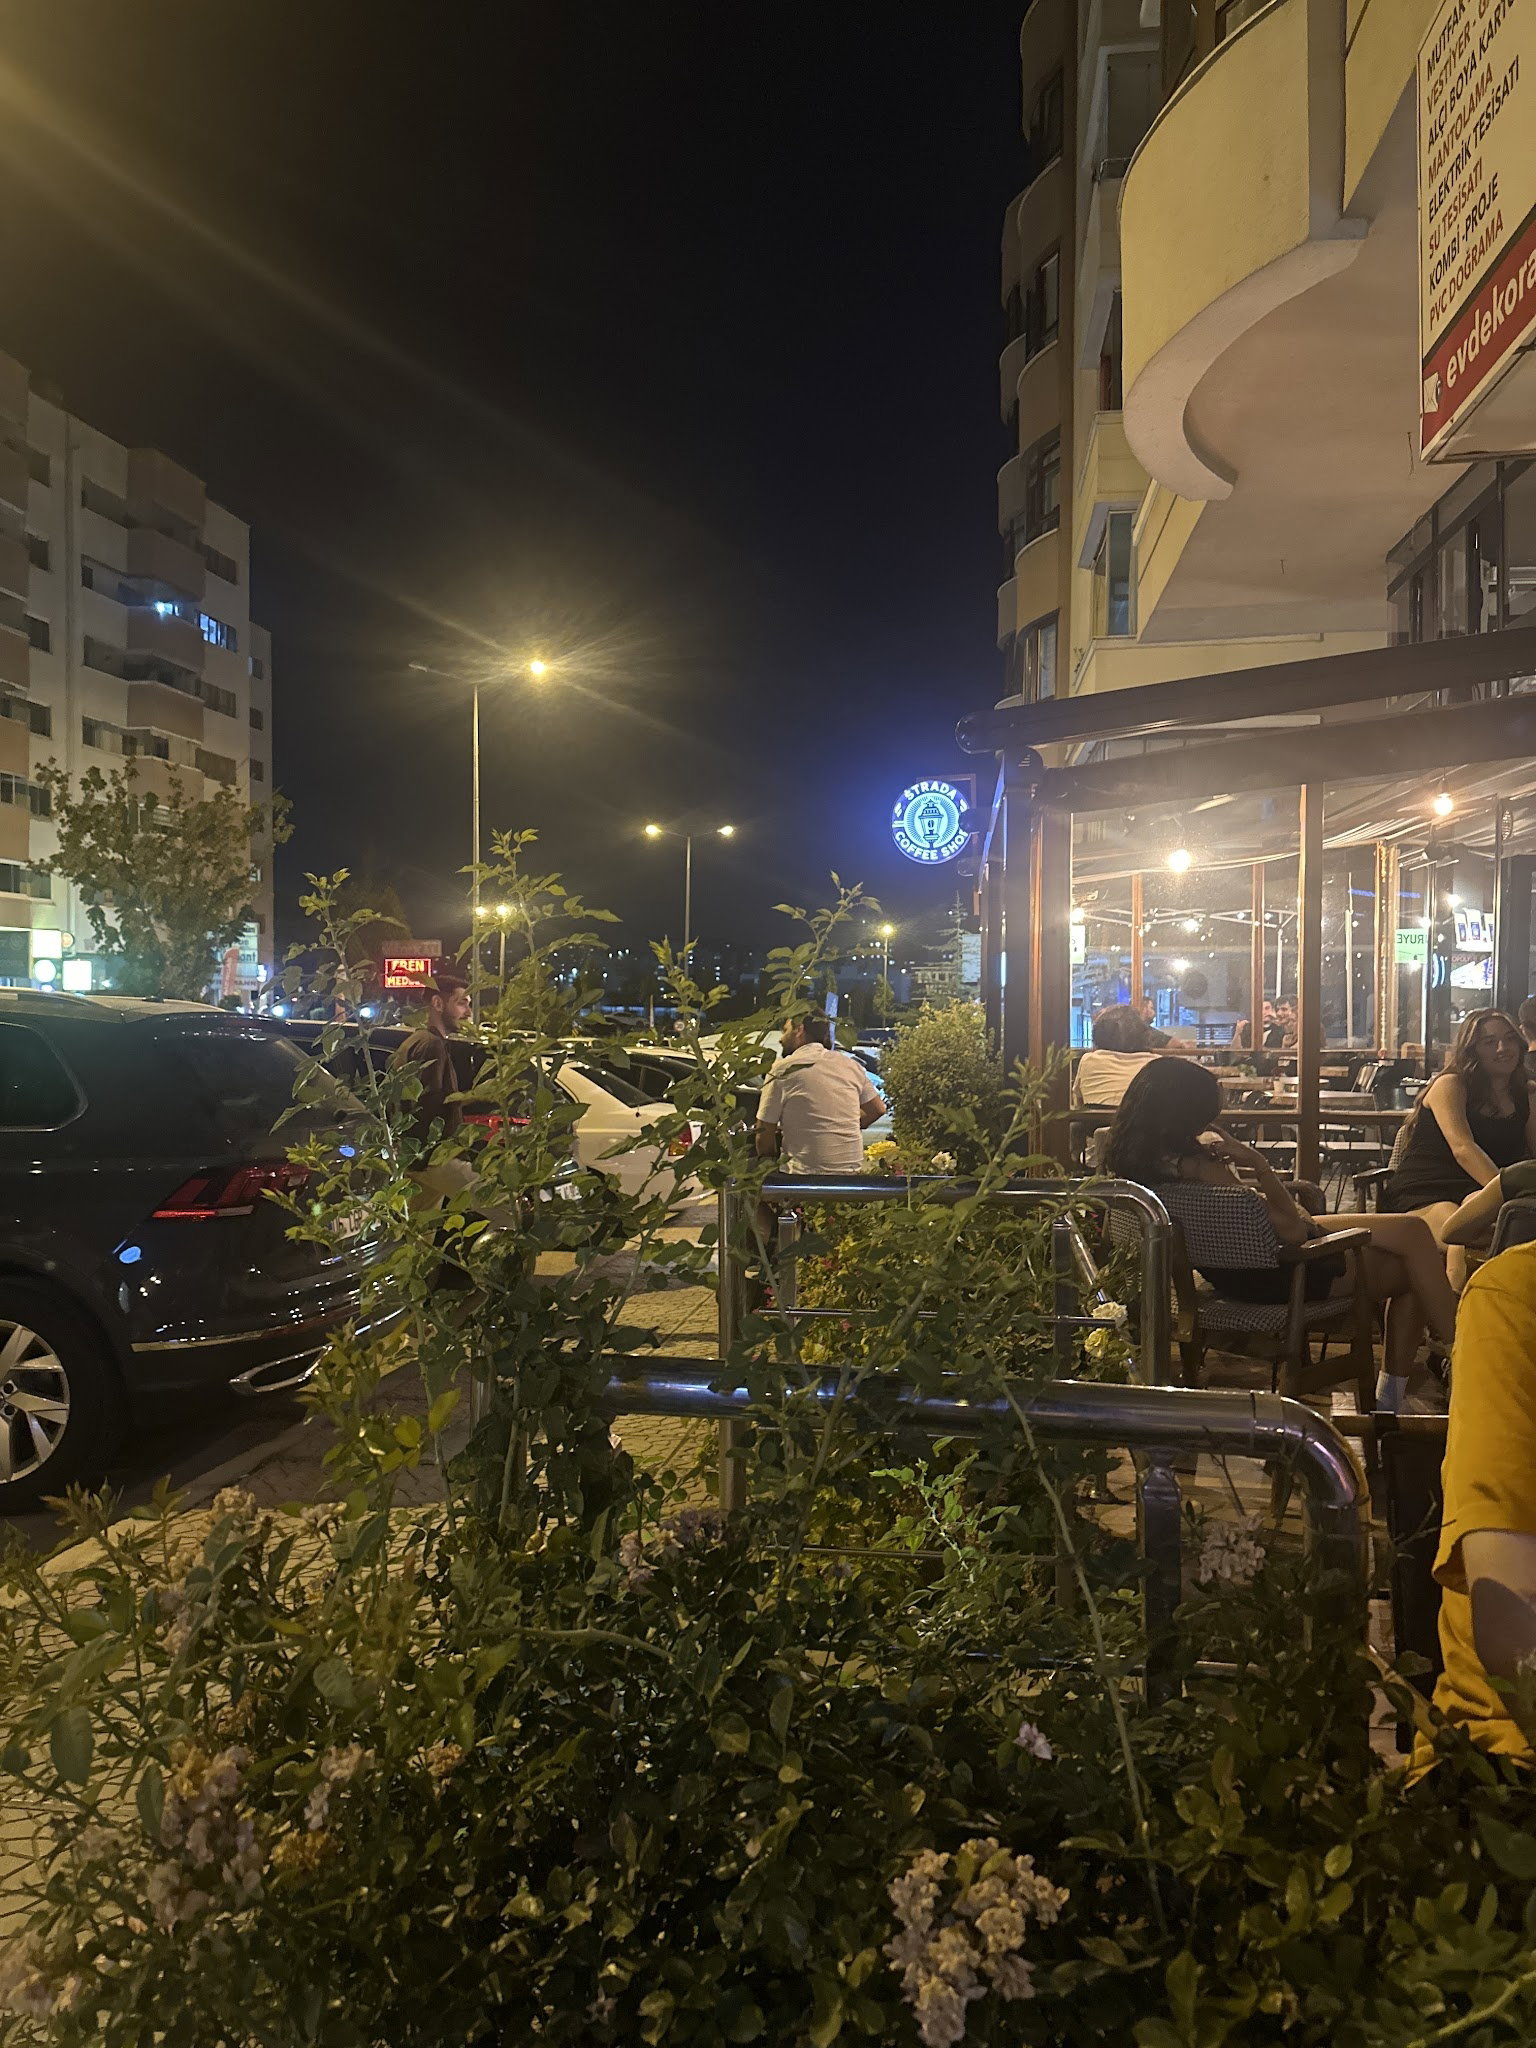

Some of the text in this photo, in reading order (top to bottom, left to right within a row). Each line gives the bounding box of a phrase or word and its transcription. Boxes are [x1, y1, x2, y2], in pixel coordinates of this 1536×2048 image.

[1427, 20, 1470, 115] VESTİYER
[1428, 99, 1448, 154] ALÇI
[1449, 49, 1477, 114] BOYA
[1479, 0, 1515, 61] KART
[1428, 62, 1493, 190] MANTOLAMA
[1429, 53, 1519, 224] ELEKTRİK TESİSATI
[1429, 155, 1483, 260] SU TESİSATI
[1429, 223, 1460, 296] KOMBİ
[1429, 208, 1504, 332] PVC DOĞRAMA
[903, 780, 957, 801] STRADA
[895, 831, 938, 860] COFFEE
